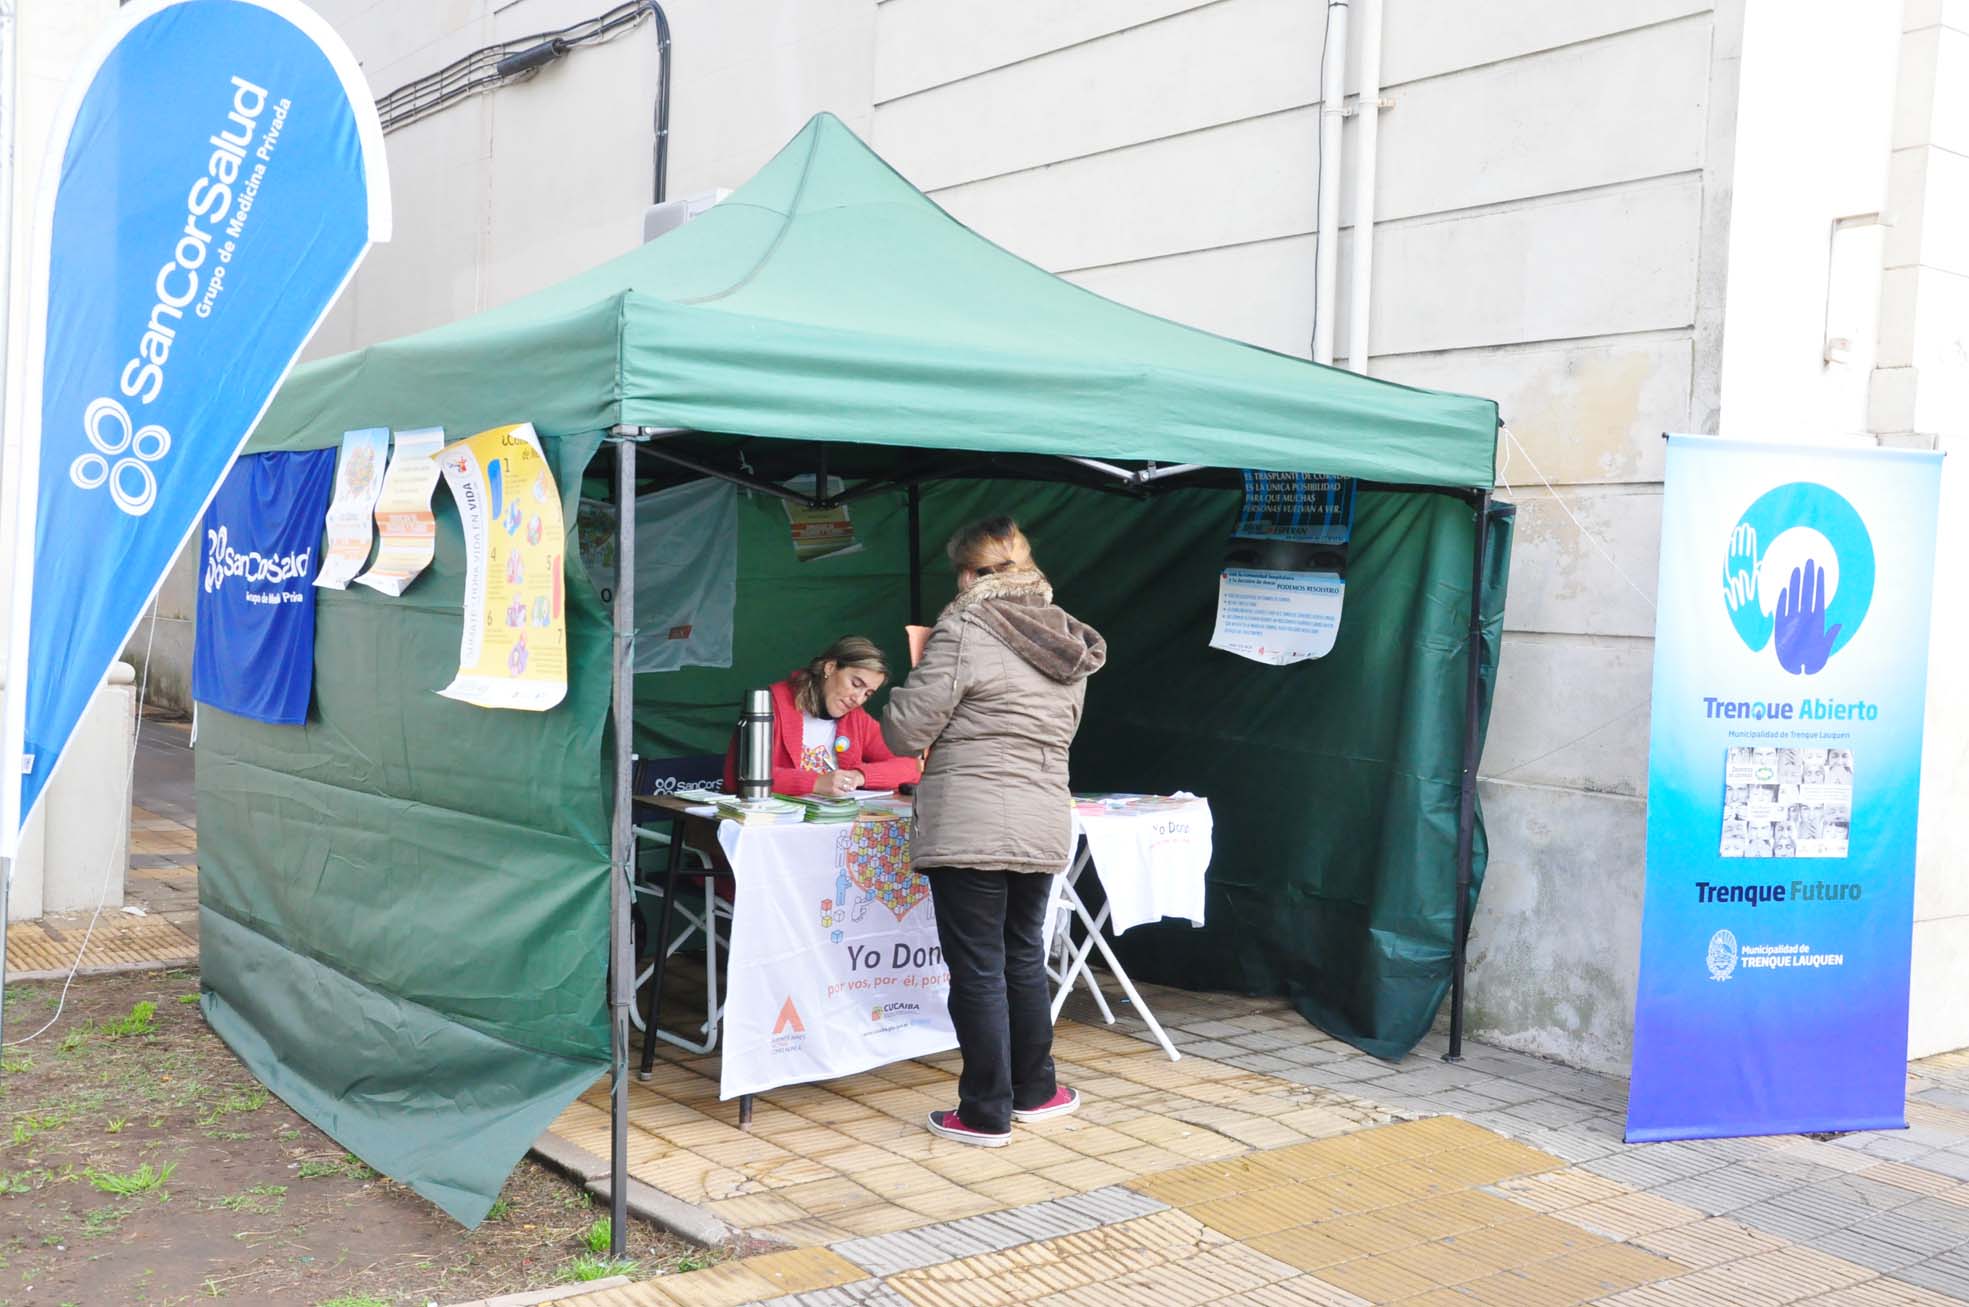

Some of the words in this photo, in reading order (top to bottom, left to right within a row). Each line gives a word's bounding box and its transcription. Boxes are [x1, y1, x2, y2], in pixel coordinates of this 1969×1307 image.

[256, 98, 292, 161] Privada
[225, 163, 267, 239] Medicina
[120, 75, 268, 404] SanCorSalud
[217, 240, 235, 263] de
[195, 266, 227, 318] Grupo
[462, 483, 477, 510] VIDA
[1245, 494, 1264, 503] PARA
[1265, 494, 1281, 503] QUE
[1282, 494, 1316, 503] MUCHAS
[1255, 483, 1265, 491] LA
[1292, 483, 1341, 492] POSIBILIDAD
[1243, 504, 1280, 513] PERSONAS
[1276, 584, 1306, 593] PODEMOS
[1703, 697, 1794, 721] Trenque
[1798, 698, 1878, 721] Abierto
[1728, 730, 1779, 739] Municipalidad
[1780, 730, 1788, 738] de
[1790, 731, 1818, 740] Trenque
[1819, 731, 1850, 740] Lauquen
[677, 778, 724, 792] SanCorS
[1695, 881, 1786, 907] Trenque
[1790, 880, 1862, 901] Futuro
[847, 944, 880, 971] Yo
[892, 943, 941, 969] Don
[1741, 944, 1799, 955] Municipalidad
[1799, 944, 1810, 953] de
[1741, 955, 1792, 969] TRENQUE
[1792, 954, 1844, 968] LAUQUEN
[827, 982, 845, 999] por
[847, 979, 871, 991] vos,
[874, 975, 898, 991] por
[922, 975, 941, 989] por
[883, 1001, 921, 1012] CUCAIBA
